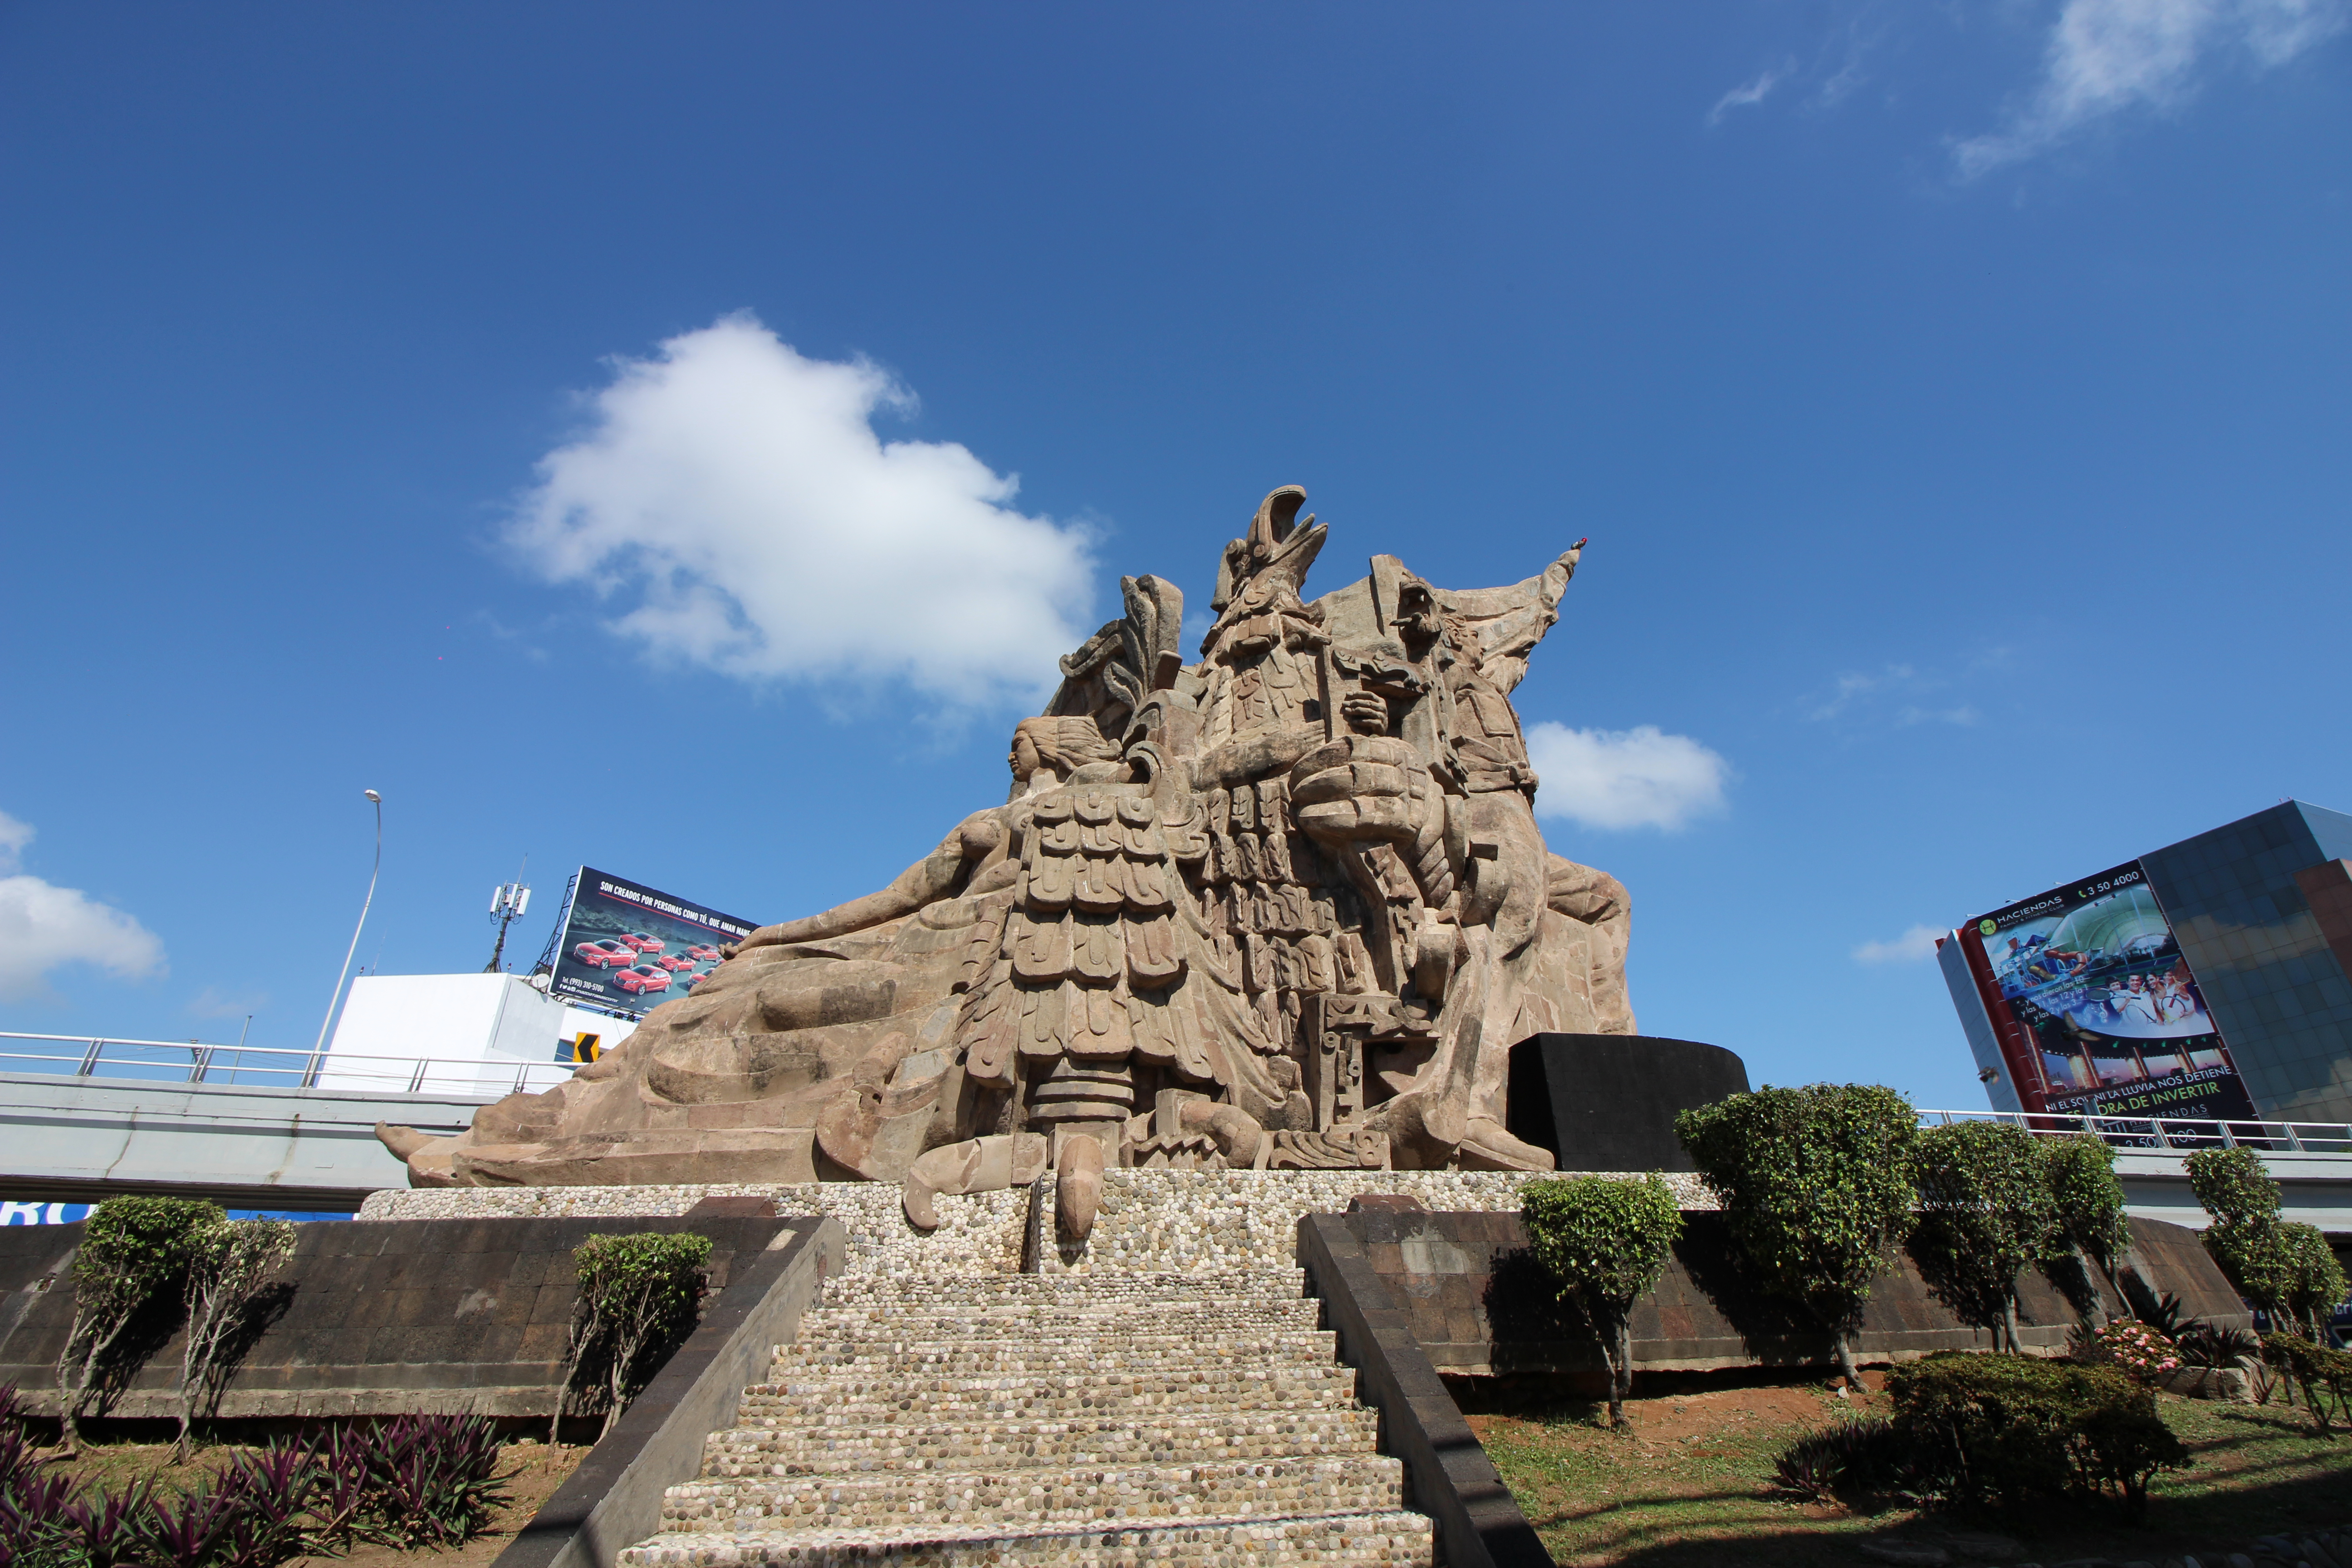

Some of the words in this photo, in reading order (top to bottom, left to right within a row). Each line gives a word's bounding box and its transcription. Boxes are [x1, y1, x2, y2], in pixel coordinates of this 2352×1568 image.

[2087, 887, 2095, 895] 3
[2097, 882, 2110, 892] 50
[2113, 871, 2139, 886] 4000
[600, 881, 613, 893] SON
[614, 886, 641, 902] CREADOS
[641, 895, 653, 906] POR
[653, 899, 683, 916] PERSONAS
[683, 909, 699, 921] COMO
[699, 913, 707, 926] TÚ,
[709, 917, 720, 928] QUE
[720, 922, 736, 933] AMAN
[736, 926, 753, 937] MANE
[1997, 896, 2063, 924] HACIENDAS
[2025, 910, 2048, 920] FITNESS
[569, 978, 582, 988] (993)
[583, 980, 604, 993] 310-5700
[2042, 986, 2063, 997] dieron
[2074, 976, 2084, 984] 10
[2045, 1103, 2057, 1112] NI
[2058, 1099, 2069, 1109] EL
[2094, 1093, 2106, 1102] NI
[2107, 1090, 2121, 1099] LA
[2121, 1083, 2156, 1096] LLUVIA
[2157, 1076, 2182, 1088] NOS
[2185, 1066, 2232, 1082] DETIENE
[2098, 1102, 2127, 1116] ORA
[2129, 1096, 2150, 1109] DE
[2151, 1082, 2220, 1104] INVERTIR
